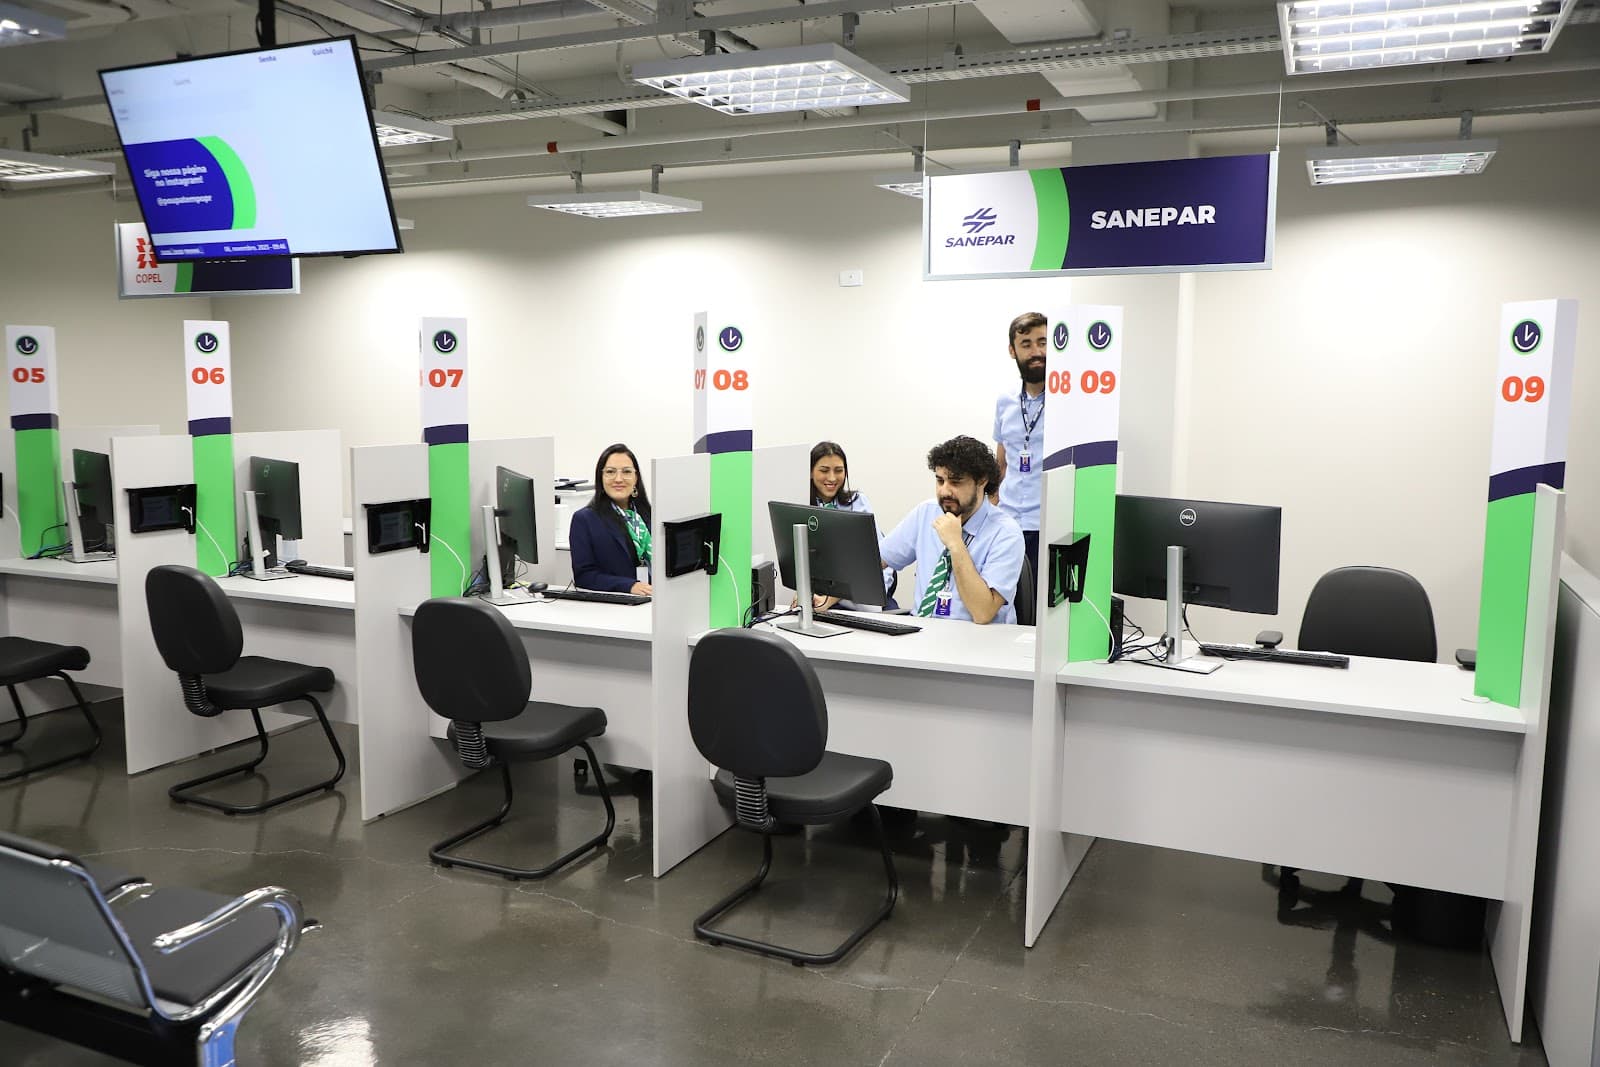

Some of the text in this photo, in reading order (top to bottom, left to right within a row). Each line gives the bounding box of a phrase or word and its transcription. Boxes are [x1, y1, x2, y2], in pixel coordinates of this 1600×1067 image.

[144, 169, 160, 179] Siga
[182, 164, 208, 176] página
[1090, 205, 1216, 230] SANEPAR
[945, 234, 1015, 248] SANEPAR
[136, 274, 162, 284] COPEL
[13, 368, 45, 383] 05
[192, 368, 225, 384] 06
[428, 369, 464, 388] 07
[694, 369, 706, 390] 07
[713, 370, 749, 391] 08
[1049, 371, 1071, 394] 08
[1081, 370, 1116, 394] 09
[1502, 376, 1545, 403] 09
